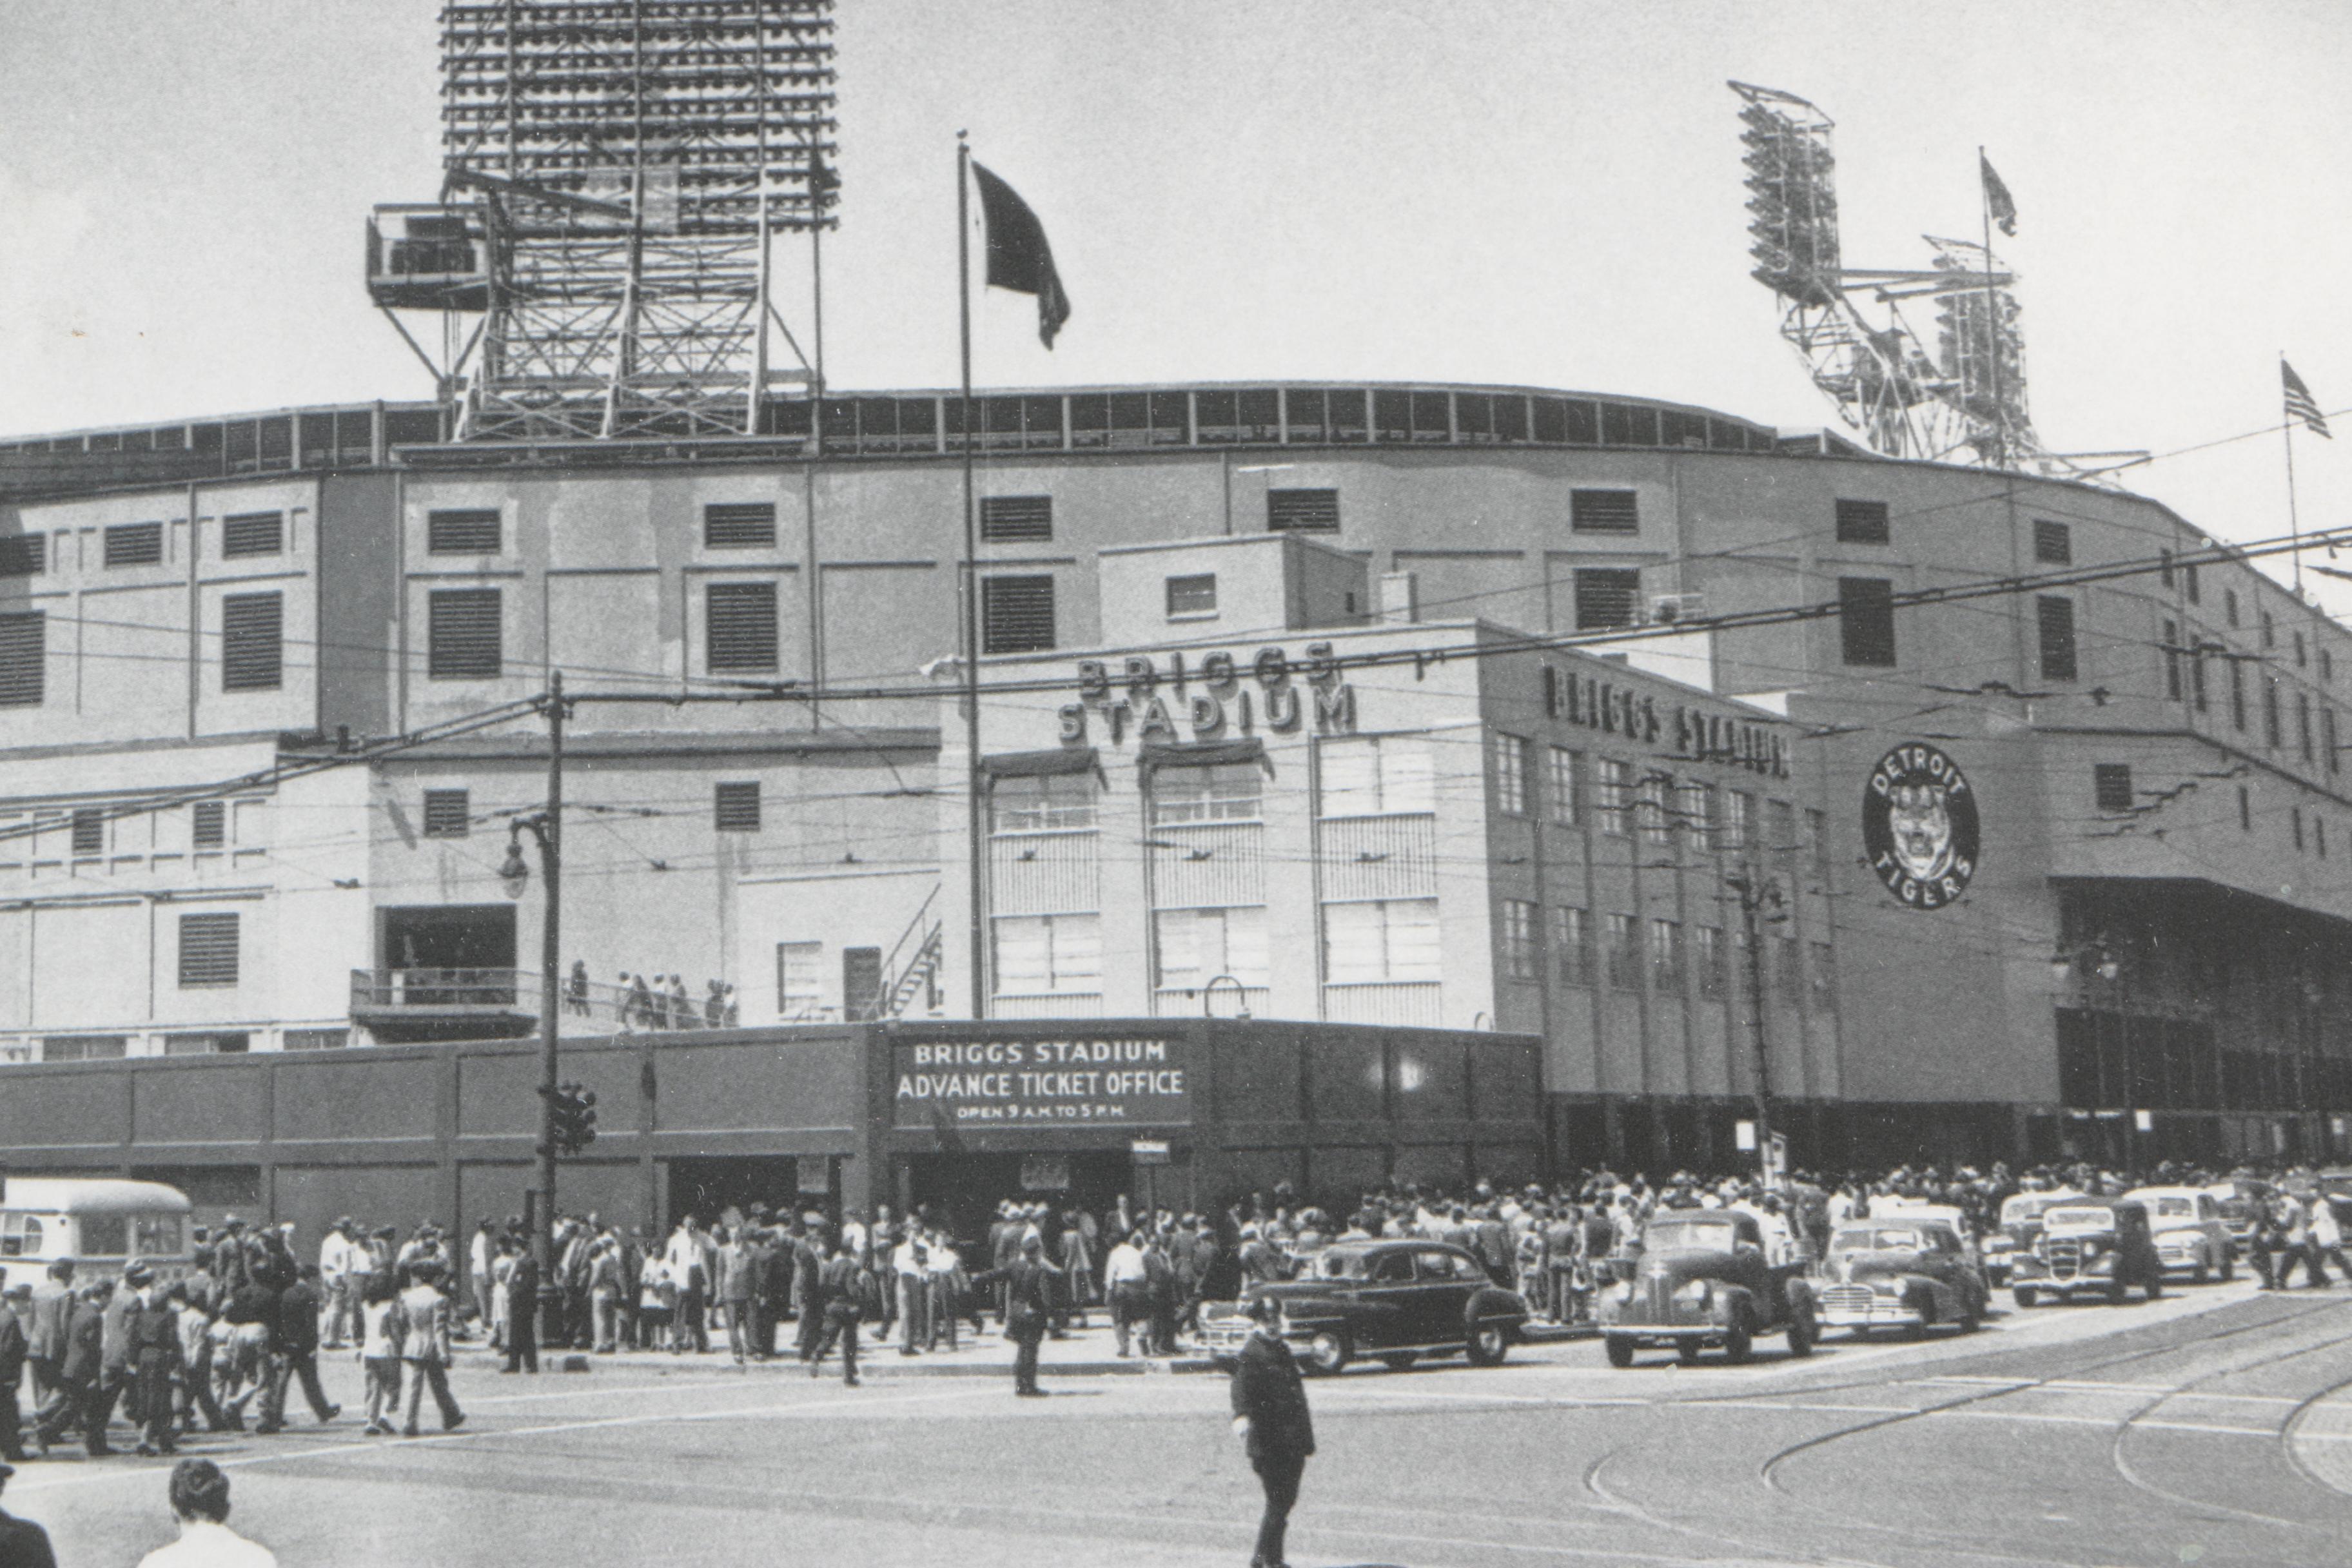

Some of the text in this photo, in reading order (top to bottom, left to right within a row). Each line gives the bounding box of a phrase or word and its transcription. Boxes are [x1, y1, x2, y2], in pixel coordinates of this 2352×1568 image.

[1077, 642, 1336, 700] BRIGGS
[1059, 684, 1355, 745] STADIUM
[1872, 747, 1965, 795] DETROIT
[1876, 850, 1971, 905] TIGERS
[915, 1041, 1166, 1064] BRIGGS STADIUM
[897, 1071, 1183, 1097] ADVANCE TICKET OFFICE
[957, 1106, 1003, 1119] OPEN
[1008, 1104, 1019, 1118] 9
[1056, 1105, 1077, 1117] TO
[1081, 1104, 1091, 1117] 5
